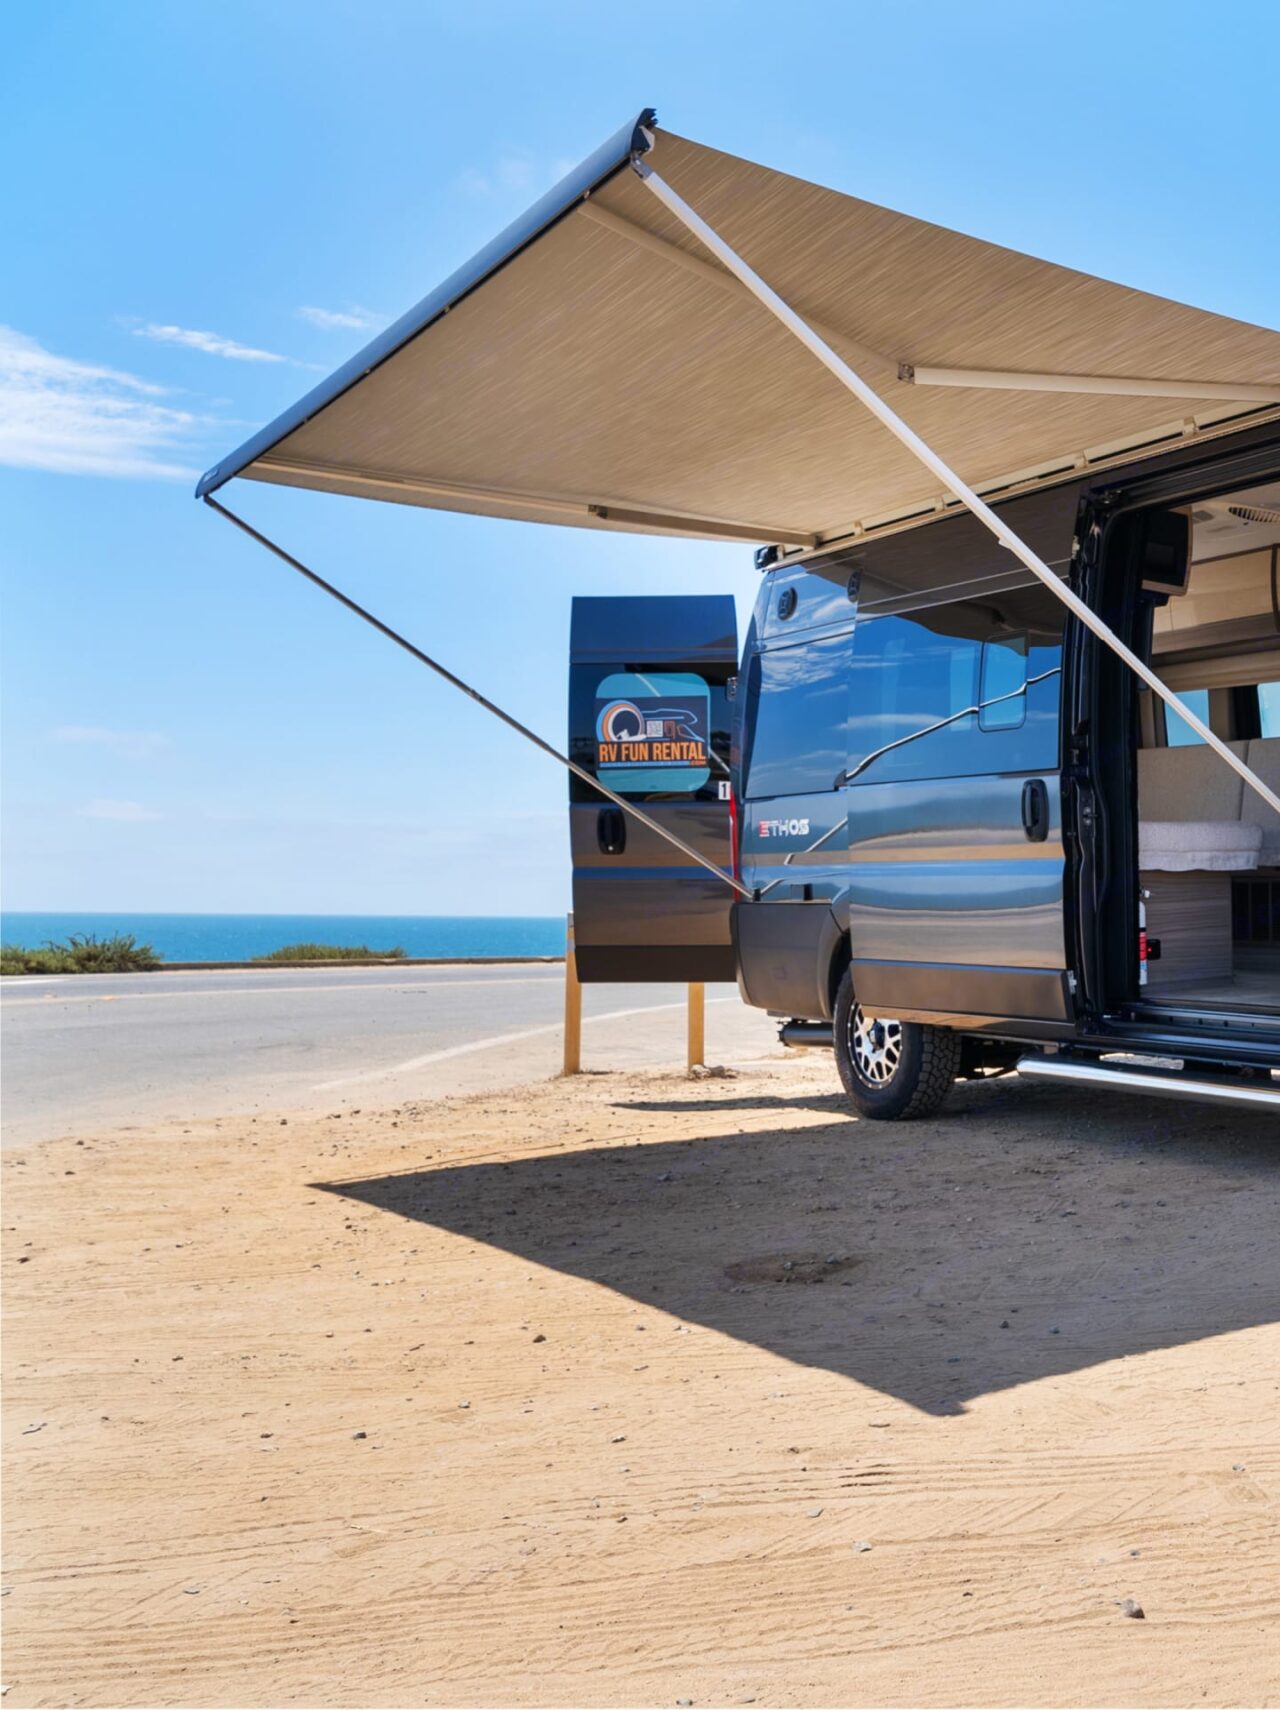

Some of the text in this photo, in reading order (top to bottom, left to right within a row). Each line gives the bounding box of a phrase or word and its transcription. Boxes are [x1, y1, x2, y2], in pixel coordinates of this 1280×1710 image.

[599, 741, 706, 762] RV FUN RENTAL
[721, 782, 727, 799] 1
[759, 818, 809, 837] ETHOS
